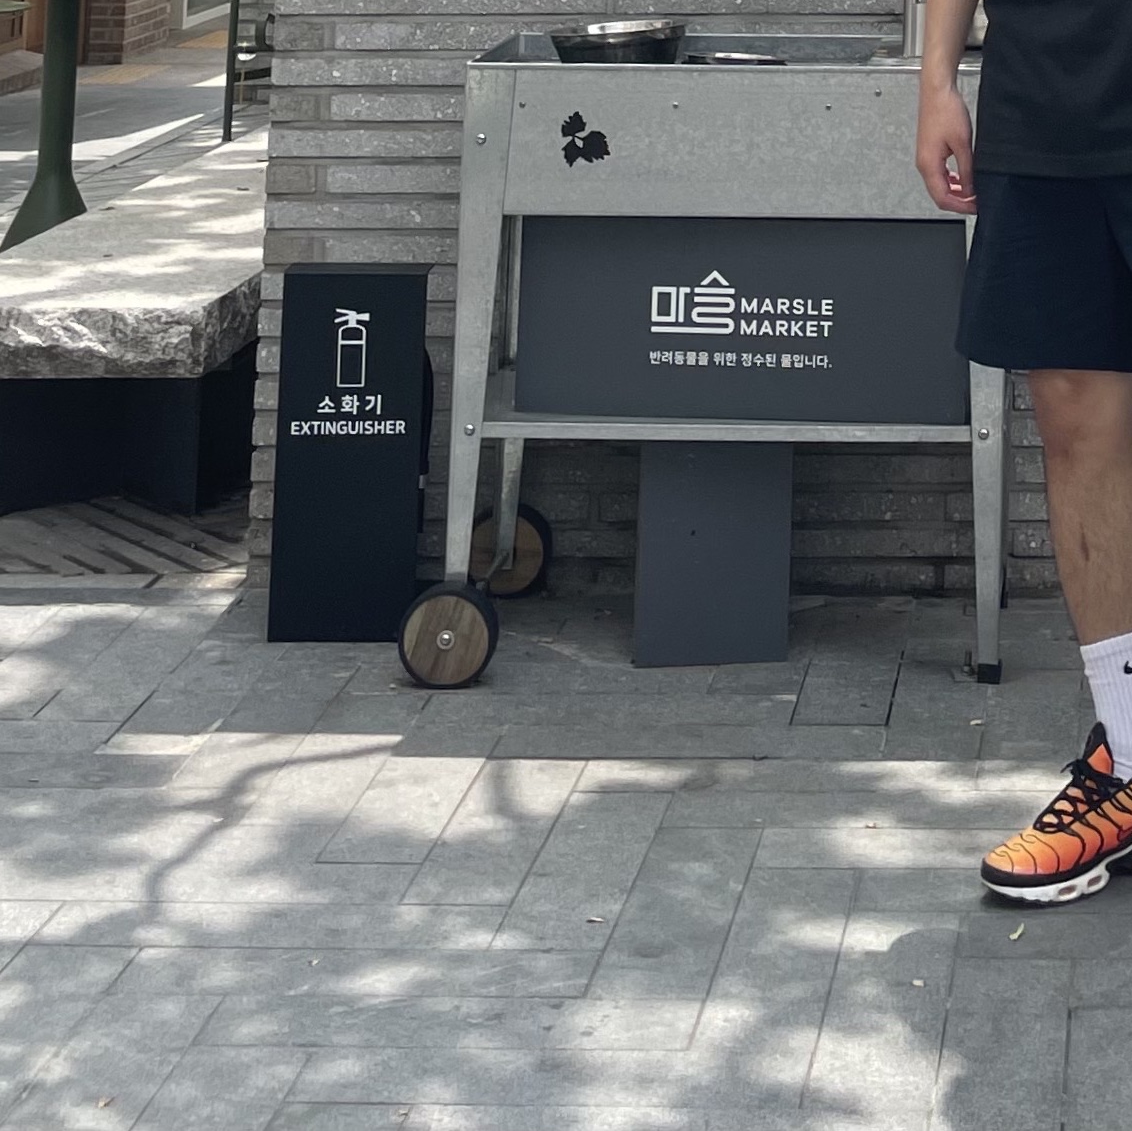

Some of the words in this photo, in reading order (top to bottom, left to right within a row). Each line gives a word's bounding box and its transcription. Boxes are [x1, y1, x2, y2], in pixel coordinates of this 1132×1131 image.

[740, 297, 834, 316] MARSLE
[739, 319, 834, 337] MARKET
[649, 350, 709, 366] 반려동물을
[713, 351, 738, 367] 위한
[740, 352, 777, 367] 정수된
[316, 394, 382, 416] 소화기
[290, 420, 406, 436] EXTINGUISHER
